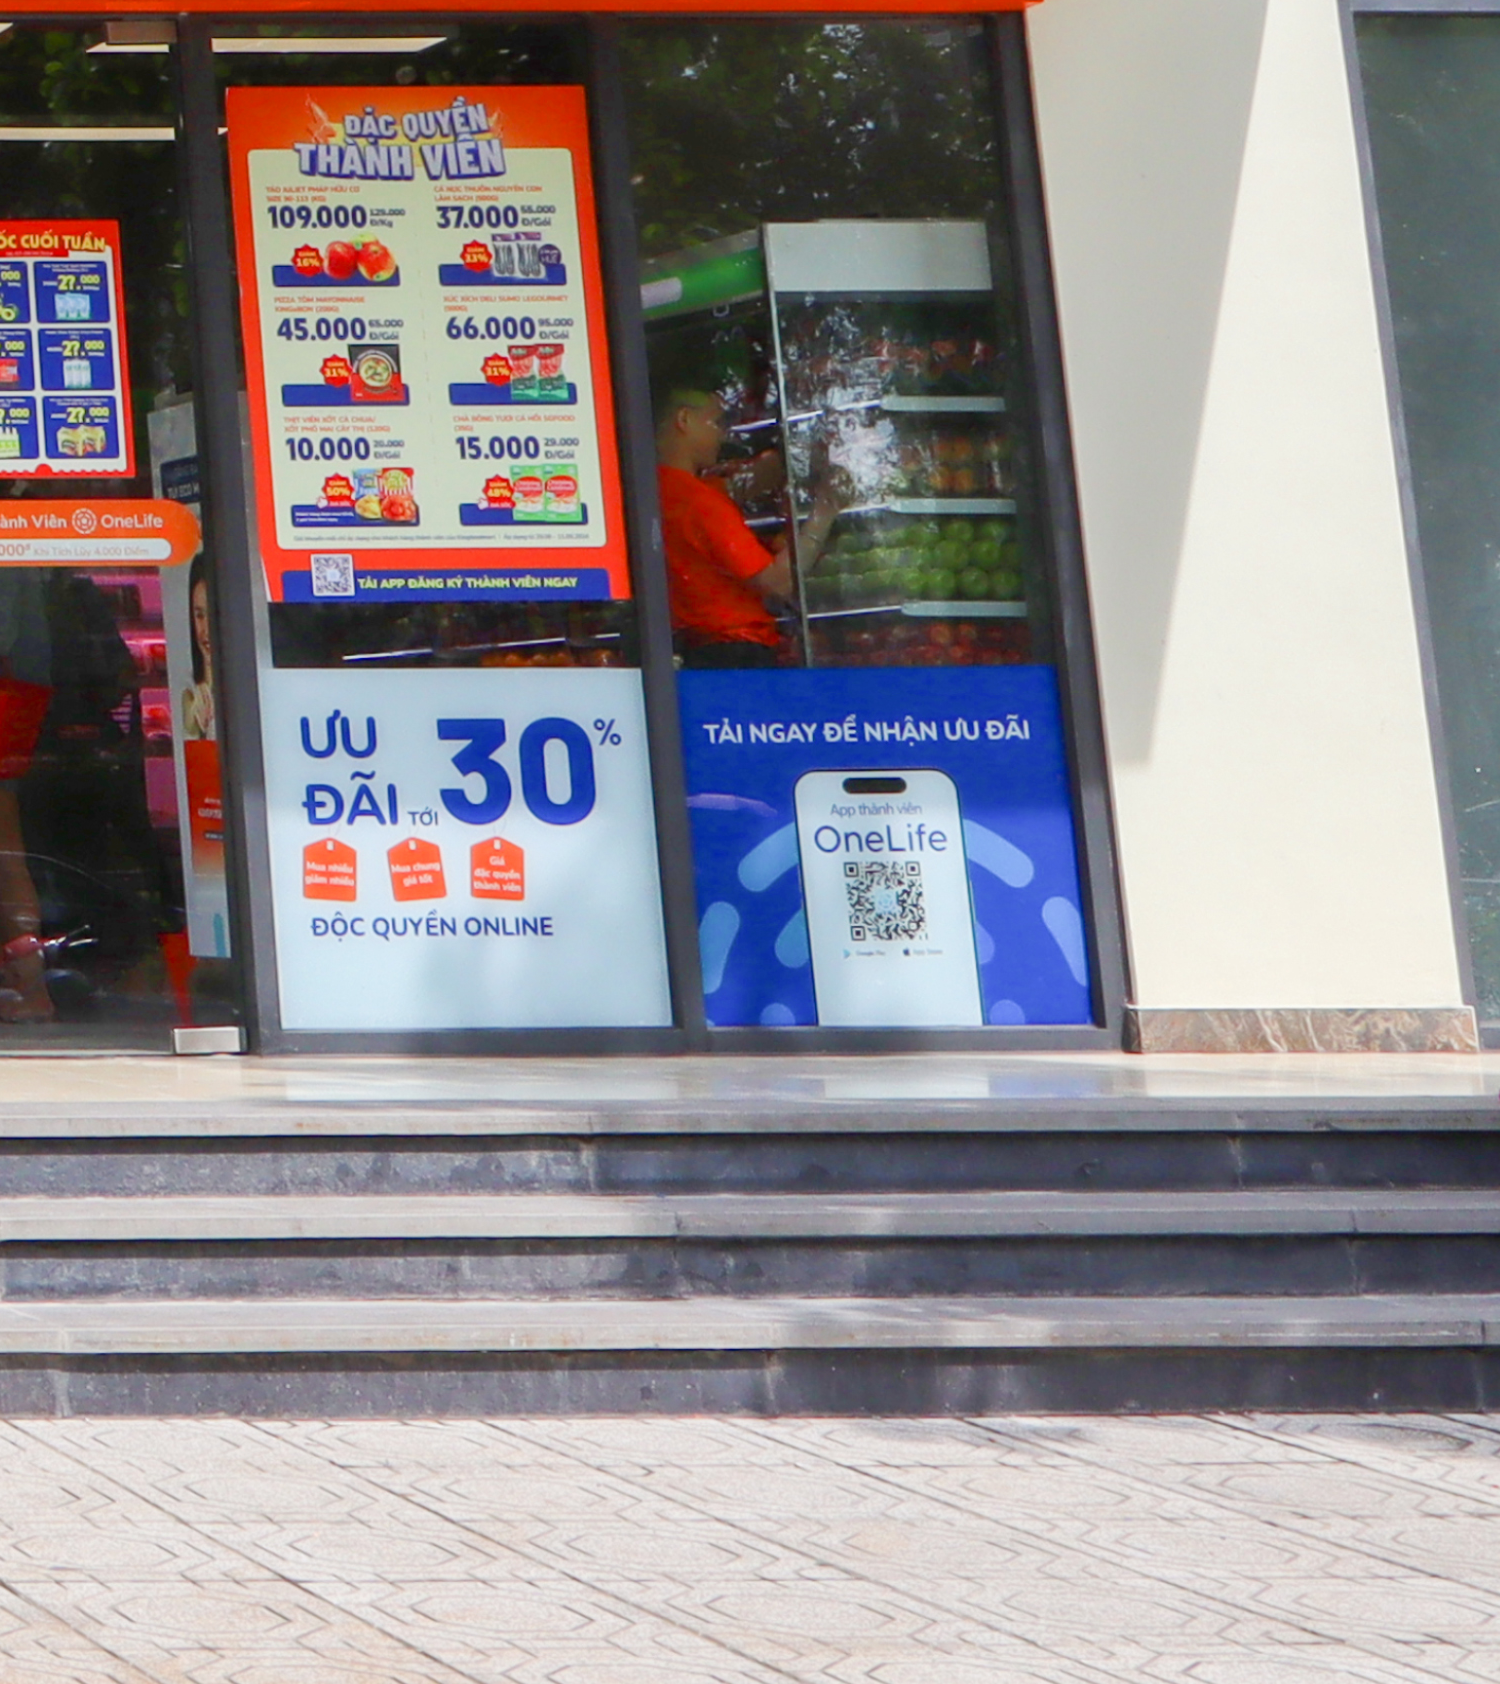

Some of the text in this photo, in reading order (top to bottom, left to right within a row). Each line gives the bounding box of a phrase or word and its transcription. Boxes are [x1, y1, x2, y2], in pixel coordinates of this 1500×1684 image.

[344, 97, 490, 143] ĐẶC QUYỀN
[294, 137, 506, 180] THÀNH VIÊN
[268, 205, 367, 228] 109.000
[436, 205, 518, 228] 37.000
[21, 230, 59, 249] CUỐI
[62, 232, 105, 251] TUẦN
[277, 318, 366, 340] 45.000
[446, 316, 535, 340] 66.000
[286, 437, 370, 461] 10.000
[456, 436, 540, 459] 15.000
[31, 514, 67, 528] Viên
[101, 513, 163, 528] OneLife
[358, 574, 578, 589] TẢI APP ĐĂNG KÝ THÀNH VIÊN NGAY
[300, 710, 377, 759] ƯU
[703, 714, 1030, 746] TẢI NGAY ĐỂ NHẬN ƯU ĐÃI
[302, 771, 399, 826] ĐÃI
[407, 806, 439, 826] TỚI
[830, 802, 922, 817] App thành viên
[814, 823, 947, 853] OneLife
[306, 861, 353, 874] Mua nhiều
[391, 861, 440, 873] Mua chung
[489, 856, 505, 866] Giá
[305, 874, 354, 887] giảm nhiều
[403, 873, 433, 887] giá tốt
[474, 868, 521, 881] đặc quyền
[474, 880, 522, 892] thành viên
[311, 909, 554, 942] ĐỘC QUYỀN ONLINE
